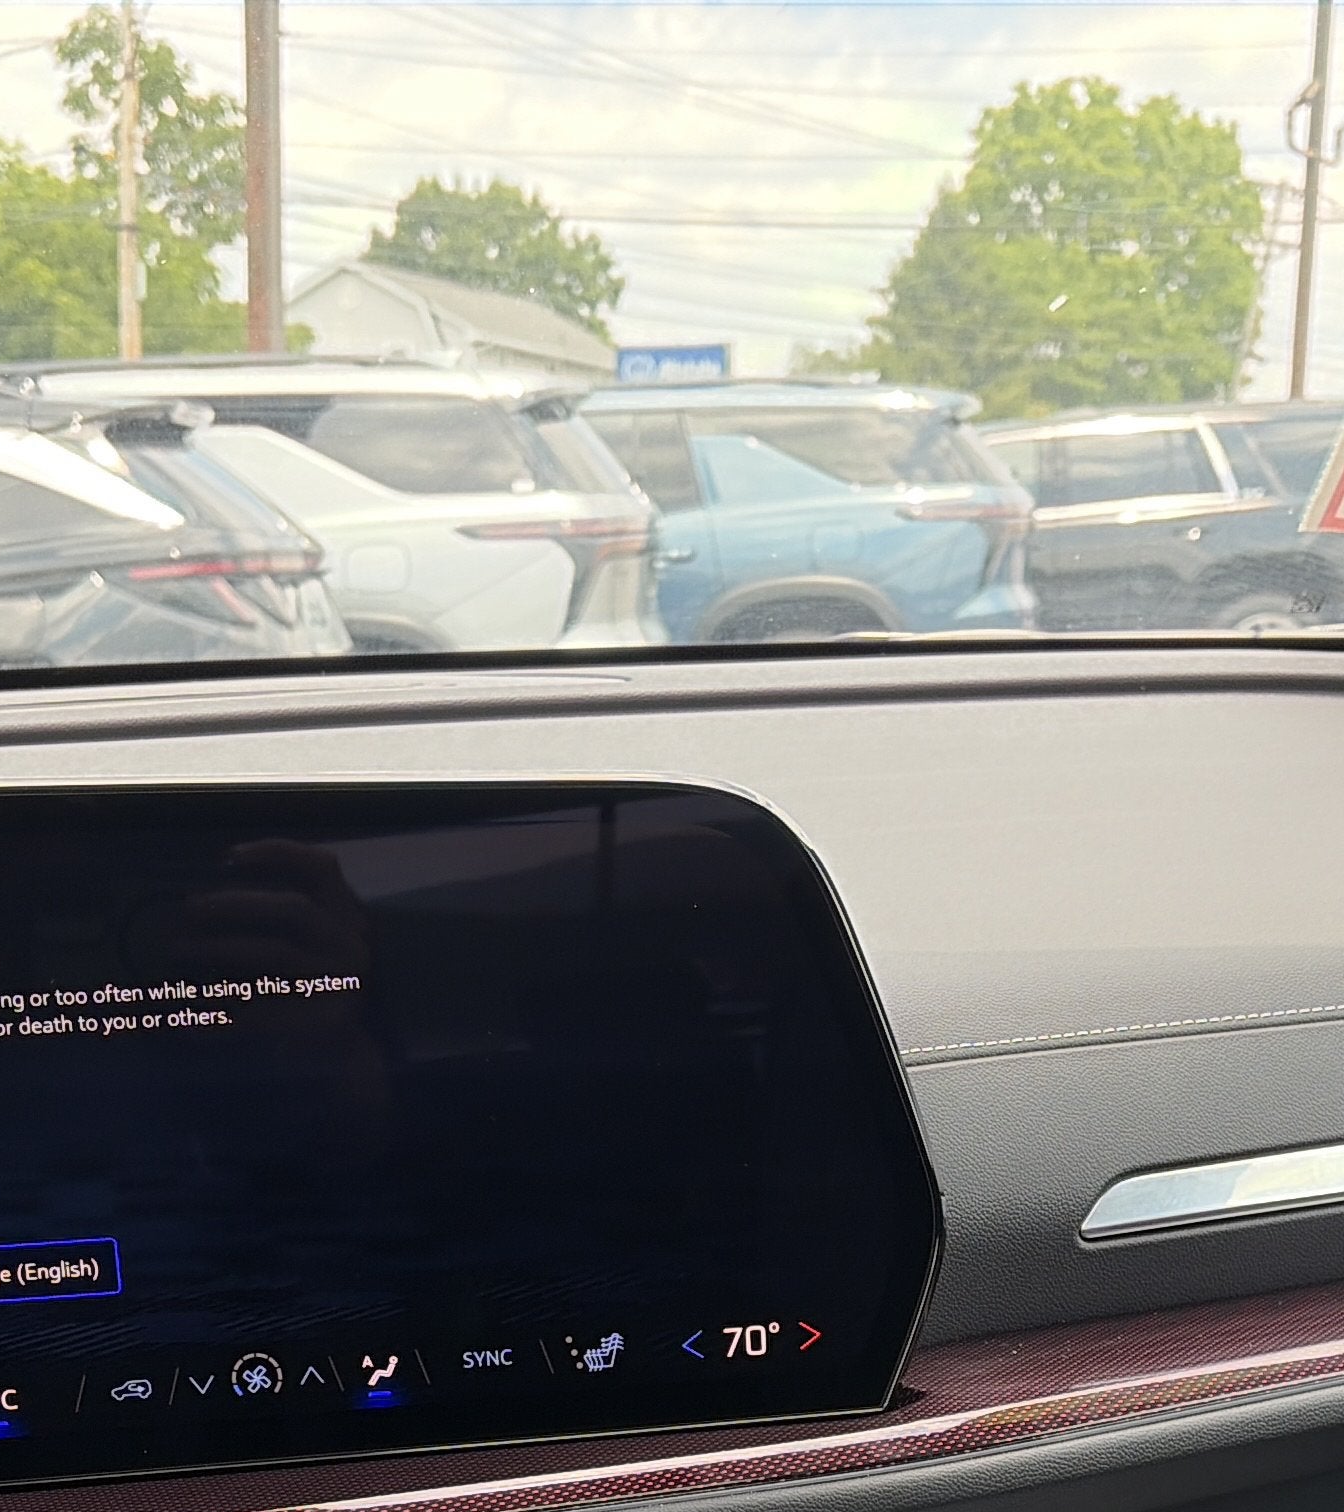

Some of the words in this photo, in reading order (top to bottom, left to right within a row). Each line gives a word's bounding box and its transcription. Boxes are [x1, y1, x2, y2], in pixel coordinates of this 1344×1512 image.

[29, 991, 51, 1008] or
[53, 989, 88, 1006] too
[92, 983, 144, 1004] often
[148, 979, 198, 1001] while
[202, 978, 253, 1001] using
[256, 975, 291, 995] this
[295, 974, 361, 998] system
[18, 1013, 74, 1036] death
[78, 1015, 99, 1033] to
[102, 1015, 138, 1036] you
[142, 1014, 164, 1030] or
[167, 1007, 234, 1027] others.
[16, 1257, 100, 1287] (English)
[721, 1321, 780, 1358] 70°
[462, 1348, 513, 1369] SYNC
